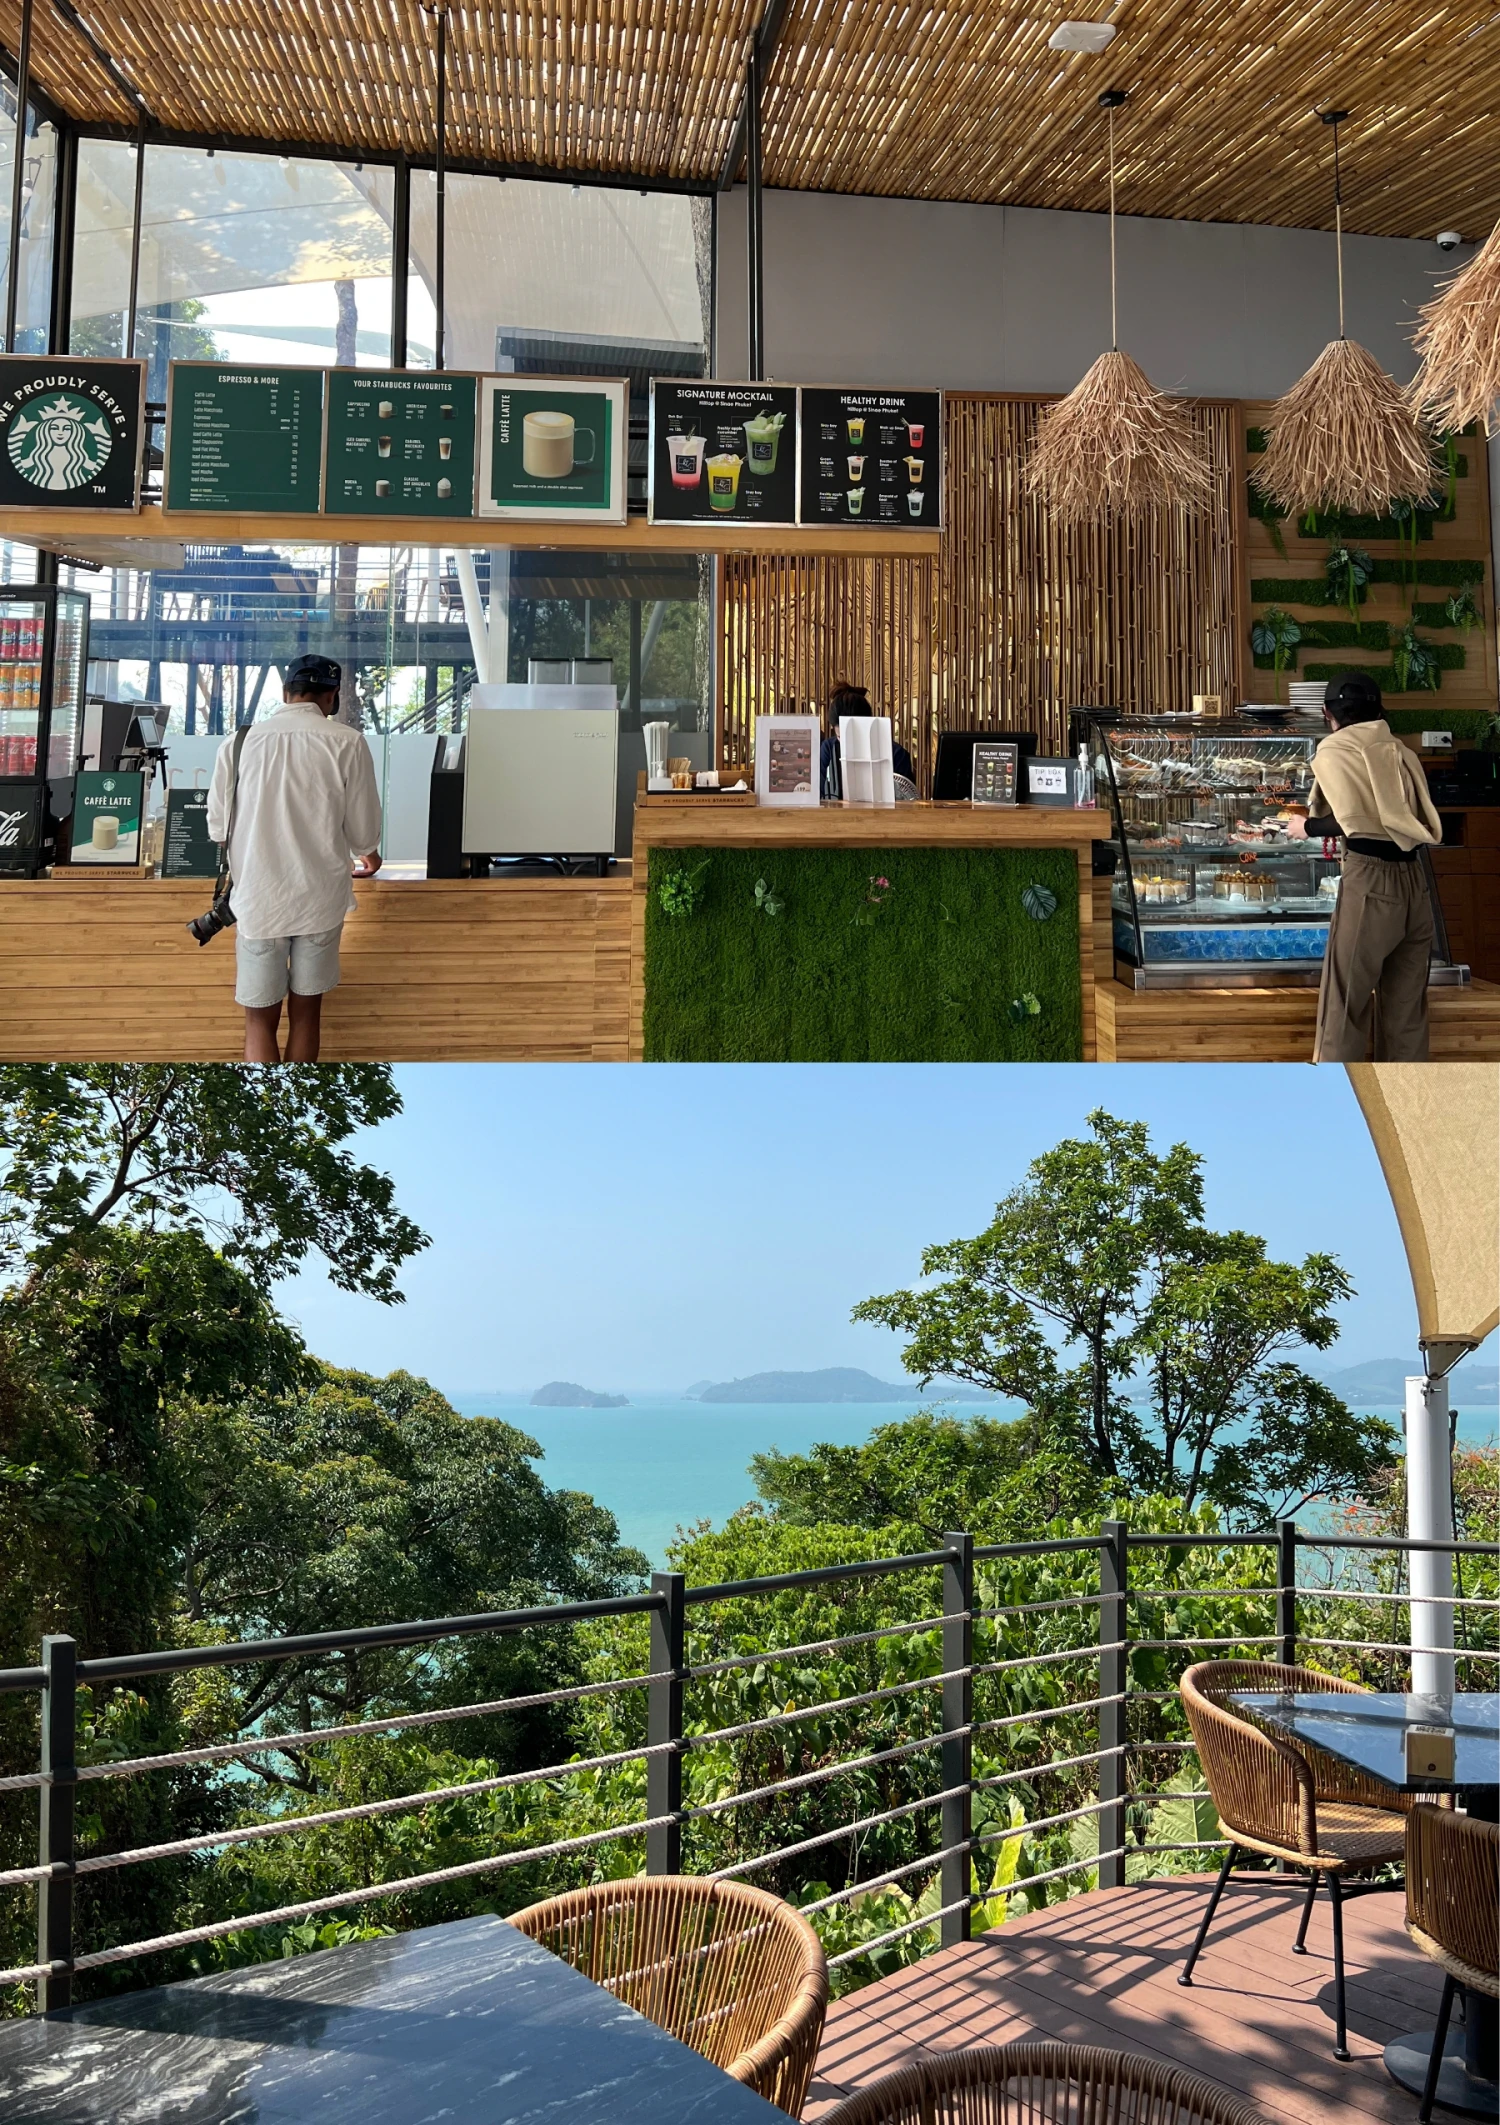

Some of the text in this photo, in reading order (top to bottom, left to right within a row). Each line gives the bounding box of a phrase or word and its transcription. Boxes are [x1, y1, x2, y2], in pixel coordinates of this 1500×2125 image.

[218, 376, 252, 384] ESPRESSO
[373, 380, 411, 389] STARBUCKS
[413, 382, 452, 391] FAVOURITES
[0, 376, 126, 424] WE PROUDLY SERVE
[677, 389, 773, 401] SIGNATURE MOCKTAIL
[840, 396, 905, 406] HEALTHY DRINK
[499, 394, 510, 443] CAFFÈ LATTE
[84, 796, 131, 806] CAFFÈ LATTE
